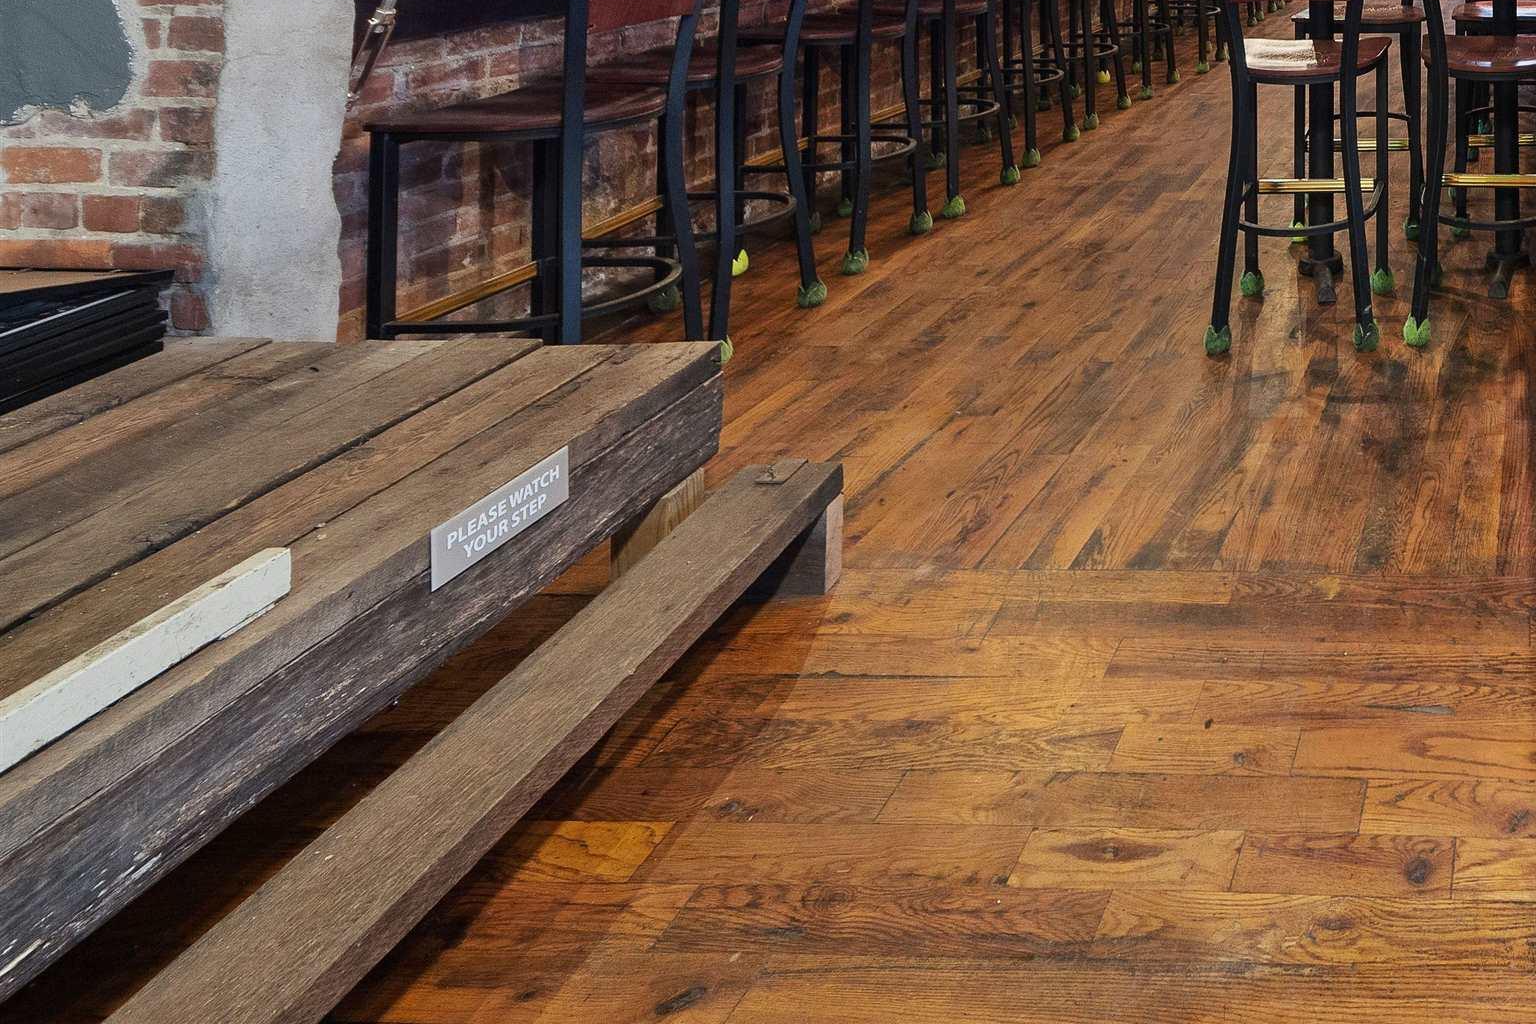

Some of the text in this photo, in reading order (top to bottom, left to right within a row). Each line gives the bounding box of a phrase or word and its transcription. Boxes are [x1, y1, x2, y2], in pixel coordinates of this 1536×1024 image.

[447, 465, 560, 550] PLEASE WATCH
[463, 493, 547, 558] YOUR STEP
